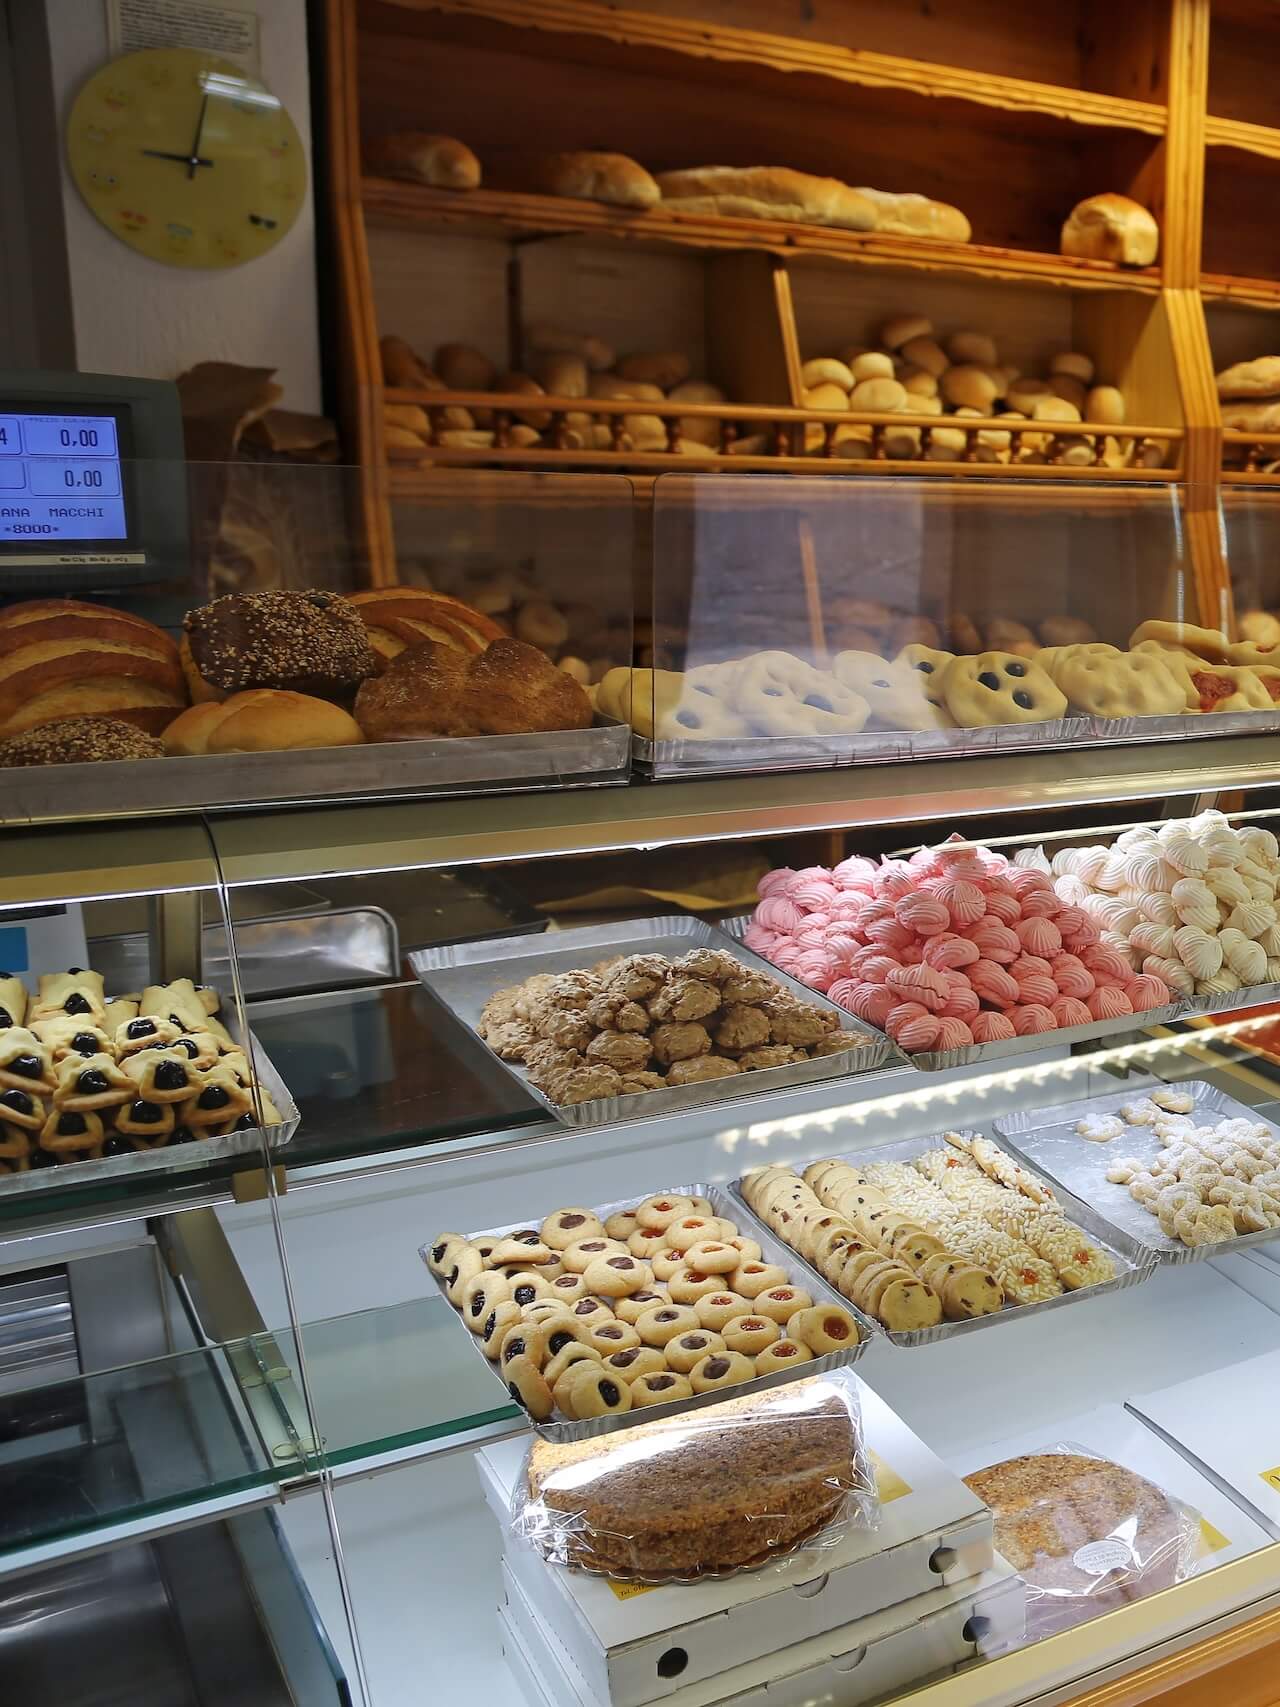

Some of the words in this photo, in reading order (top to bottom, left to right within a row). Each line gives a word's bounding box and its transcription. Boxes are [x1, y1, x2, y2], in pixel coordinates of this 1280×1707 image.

[60, 429, 98, 447] 0,00
[64, 470, 102, 487] 0,00
[48, 508, 104, 517] MACCHI
